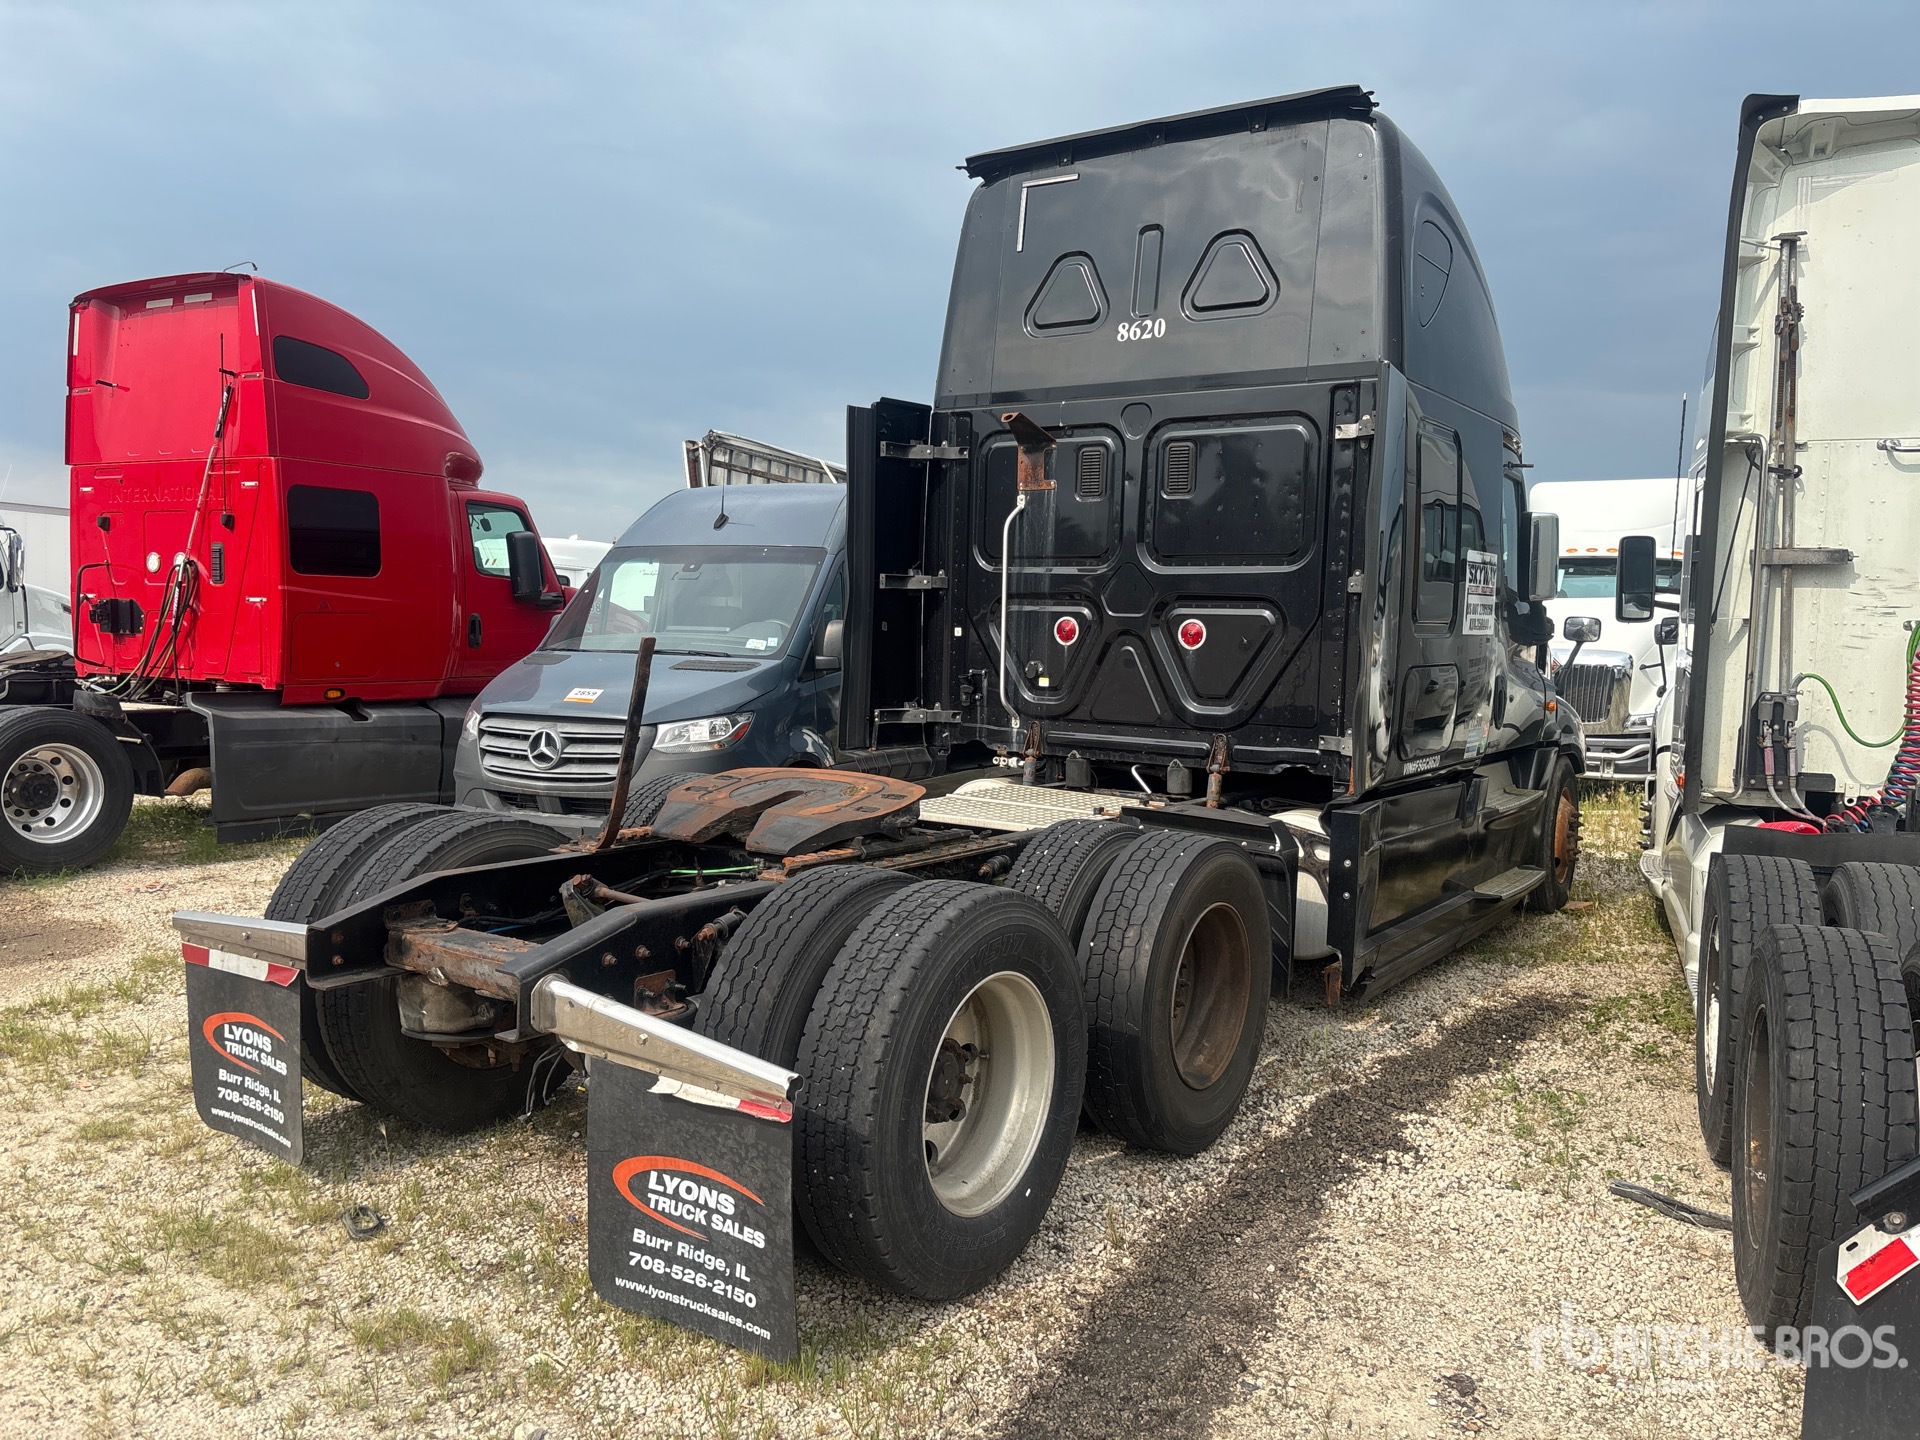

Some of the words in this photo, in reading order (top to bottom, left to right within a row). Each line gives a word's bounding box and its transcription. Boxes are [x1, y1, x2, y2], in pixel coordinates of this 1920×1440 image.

[1117, 318, 1166, 342] 8620
[223, 1023, 272, 1053] LYONS
[224, 1041, 259, 1062] TRUCK
[260, 1052, 288, 1076] SALES
[217, 1086, 285, 1125] 708-526-2150
[218, 1068, 243, 1086] Burr
[244, 1076, 272, 1101] Ridge,
[273, 1089, 282, 1104] IL
[211, 1107, 292, 1149] www.lyonstrucksales.com
[648, 1170, 735, 1216] LYONS
[647, 1193, 708, 1226] TRUCK
[711, 1213, 766, 1249] SALES
[632, 1227, 673, 1252] Burr
[677, 1241, 731, 1277] Ridge,
[735, 1262, 751, 1283] IL
[628, 1251, 757, 1309] 708-526-2150
[615, 1276, 771, 1341] www.lyonstrucksales.com
